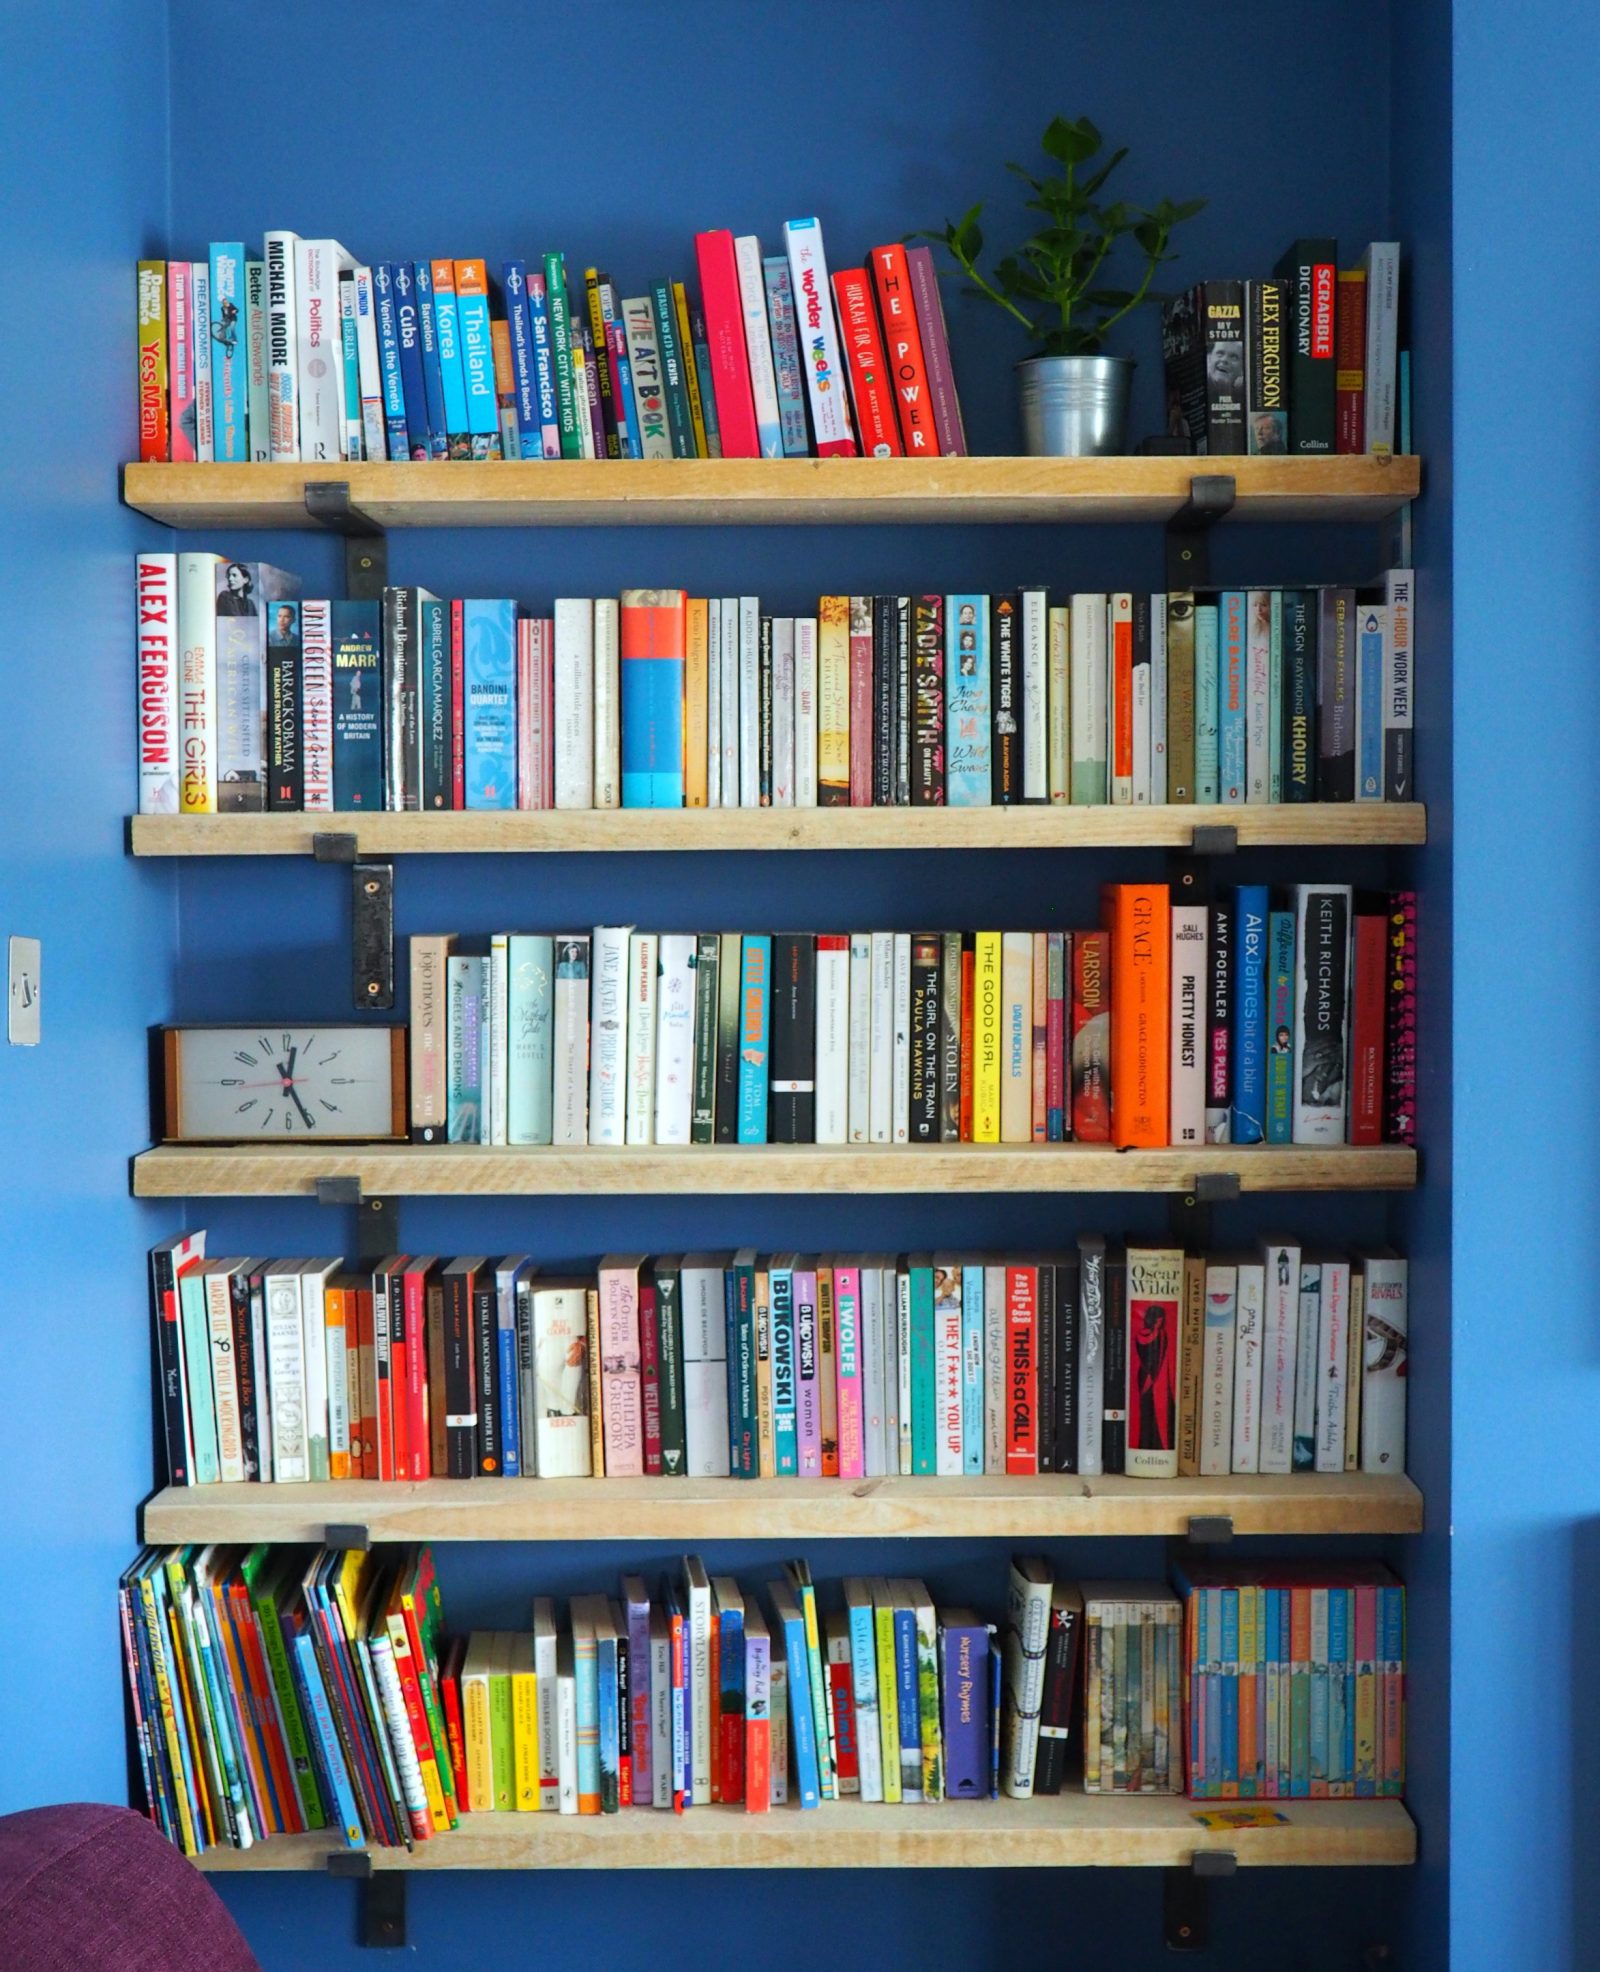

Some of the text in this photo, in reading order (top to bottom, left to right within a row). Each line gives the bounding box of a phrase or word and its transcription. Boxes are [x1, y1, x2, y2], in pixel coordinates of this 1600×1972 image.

[250, 267, 261, 306] Better
[800, 247, 812, 263] the
[197, 279, 207, 368] FREAKONOMICS
[269, 241, 287, 366] MICHAEL MOORE
[310, 299, 321, 347] Politics
[380, 300, 392, 336] Venice
[400, 306, 416, 348] Cuba
[422, 303, 433, 352] Barcelona
[438, 304, 454, 359] Korea
[534, 316, 547, 344] San
[802, 269, 822, 329] wonder
[846, 283, 874, 367] HURRAH FOR GIN
[1208, 306, 1240, 318] GAZZA
[1299, 266, 1310, 356] DICTIONARY
[1317, 269, 1330, 352] SCRABBLE
[345, 322, 355, 360] BERLIN
[384, 339, 394, 348] &
[385, 351, 395, 369] the
[465, 306, 489, 395] Thailand
[552, 298, 573, 432] NEW YORK CITY WITH KIDS
[812, 336, 832, 392] weeks
[882, 254, 926, 448] THE POWER
[1263, 284, 1280, 407] ALEX FERGUSON
[141, 339, 160, 438] Yes Man
[388, 372, 400, 411] Veneto
[539, 348, 554, 418] Francisco
[868, 389, 883, 438] KATIE KIRBY
[139, 564, 169, 763] ALEX FERGUSON
[304, 605, 322, 692] JANE GREEN
[336, 654, 376, 667] MARR
[394, 590, 407, 683] Richard Brautigan
[1001, 617, 1011, 708] THE WHITE TIGER
[1228, 597, 1240, 710] CLARE BALDING
[1336, 600, 1345, 701] SEBASTIAN FAULKS
[1394, 583, 1408, 717] THE 4-HOUR WORK WEEK
[917, 607, 938, 743] ZADIE SMITH
[1295, 658, 1304, 715] RAYMOND
[185, 689, 205, 805] THE GIRLS
[274, 723, 280, 735] MY
[282, 661, 294, 772] BARACK OBAMA
[1292, 716, 1306, 785] KHOURY
[1331, 705, 1344, 757] Birdsong
[923, 748, 931, 785] ON BEAUTY
[1133, 897, 1152, 966] GRACE
[1216, 913, 1227, 1017] AMY POEHLER
[1245, 913, 1262, 1019] Alex James
[1318, 899, 1332, 1031] KEITH RICHARDS
[600, 944, 619, 1016] JANE AUSTEN
[746, 947, 764, 1042] LITTLE CHILDREN
[984, 943, 993, 1072] THE GOOD GIRL
[1082, 940, 1101, 1008] LARSSON
[258, 1038, 274, 1056] 11
[282, 1034, 291, 1052] 12
[453, 980, 463, 1099] ANGELS AND DEMONS
[913, 990, 923, 1100] PAULA HAWKINS
[925, 972, 937, 1119] THE GIRL ON THE TRAIN
[1012, 1005, 1022, 1077] DAVID NICHOLLS
[1182, 976, 1195, 1068] PRETTY HONEST
[744, 1069, 752, 1122] PERROTTA
[754, 1084, 762, 1106] TOM
[946, 1035, 958, 1092] STOLEN
[286, 1112, 292, 1129] 6
[481, 1296, 489, 1307] TO
[481, 1309, 489, 1327] KILL
[821, 1283, 830, 1308] HUNTER
[483, 1336, 491, 1395] MOCKINGBIRD
[519, 1299, 530, 1370] OSCAR WILDE
[773, 1280, 791, 1406] BUKOWSKI
[801, 1305, 814, 1375] BUKOWSKI
[822, 1317, 831, 1353] THOMPSON
[841, 1308, 854, 1372] WOLFE
[946, 1315, 959, 1350] THEY
[741, 1323, 750, 1418] Tales of Ordinary Madness
[1013, 1328, 1030, 1442] THIS is a CALL
[484, 1404, 493, 1452] HARPER LEE
[609, 1378, 622, 1451] GREGORY
[623, 1380, 635, 1449] PHILIPPA
[646, 1383, 659, 1439] WETLANDS
[804, 1388, 813, 1437] women
[948, 1405, 960, 1433] YOU
[948, 1435, 960, 1454] UP
[1135, 1457, 1169, 1465] Collins
[145, 1602, 165, 1674] SUPERWORM
[695, 1601, 706, 1677] STORYLAND
[753, 1648, 763, 1694] Highway Rat
[855, 1618, 871, 1687] STICK MAN
[957, 1637, 973, 1723] Nursery Rhymes
[542, 1688, 552, 1766] HUGLESS DOUGLAS
[836, 1689, 852, 1753] animal
